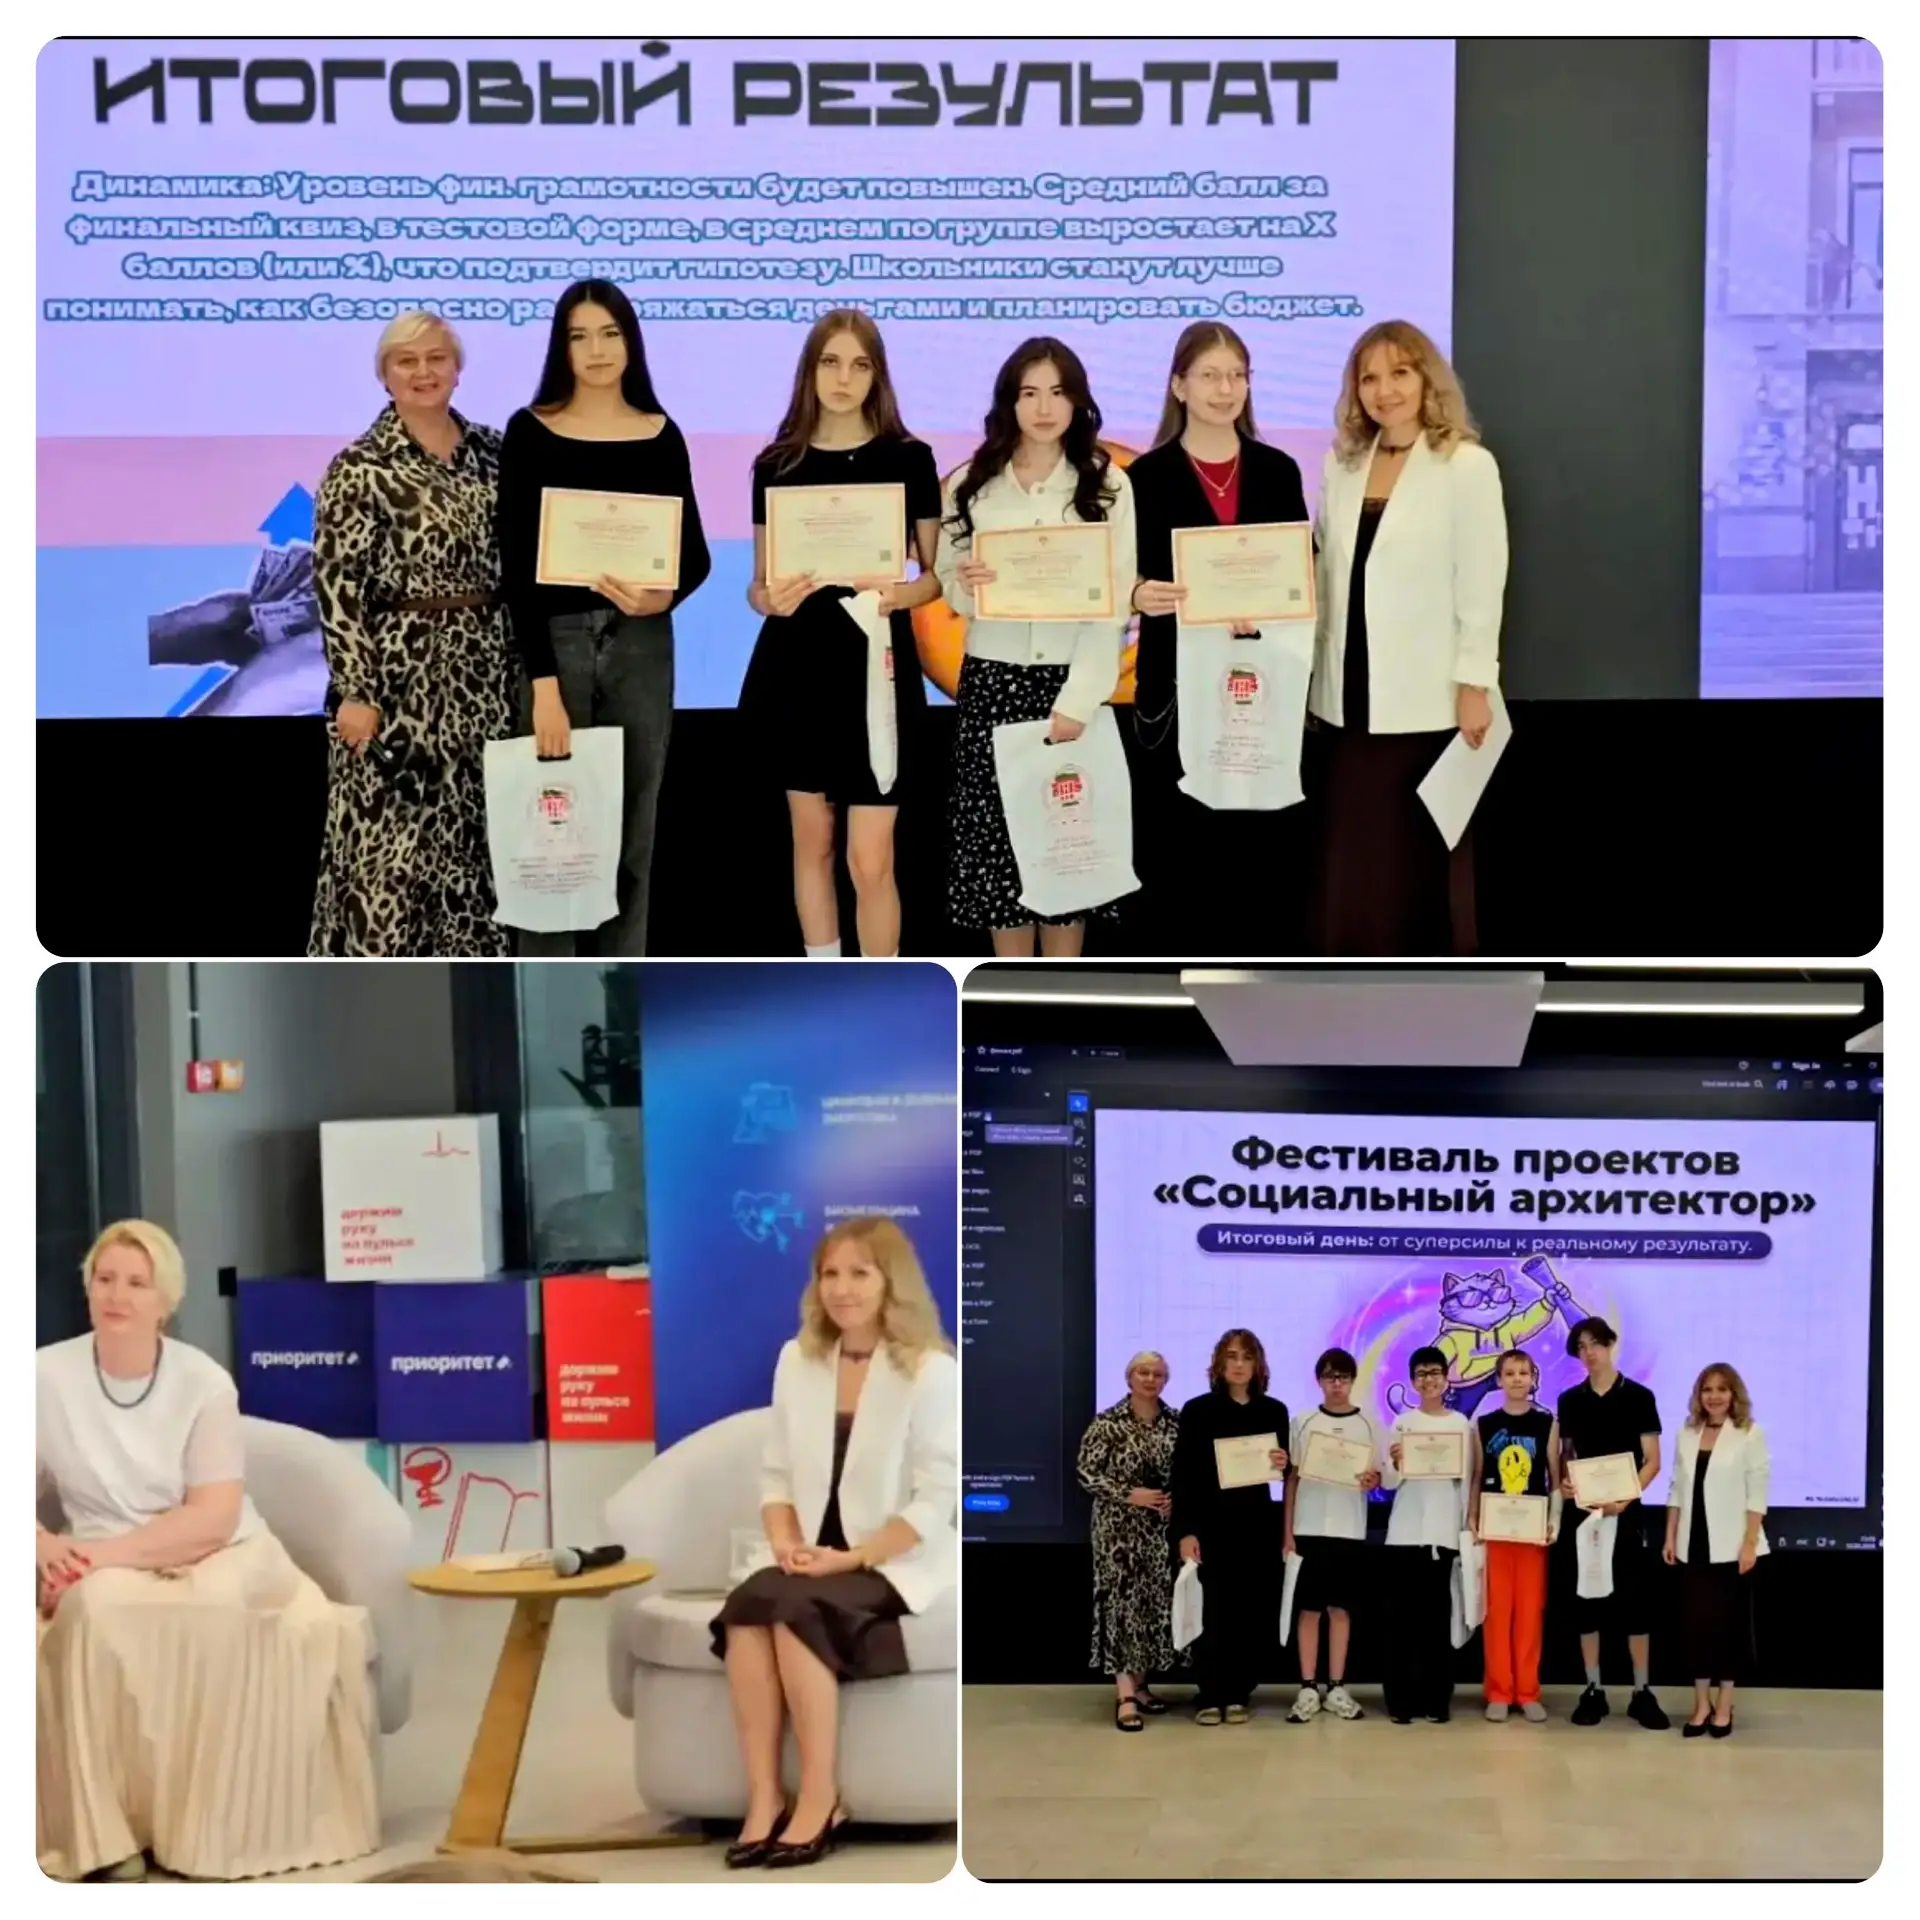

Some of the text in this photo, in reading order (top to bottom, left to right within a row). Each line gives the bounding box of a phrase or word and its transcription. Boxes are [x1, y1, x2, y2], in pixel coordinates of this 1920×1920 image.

[94, 41, 1338, 126] ИТОГОВЫЙ РЕЗУЛЬТАТ
[72, 171, 1328, 205] Динамика: Уровень фин. грамотности будет повышен. Средний балл за
[65, 212, 273, 244] финальный
[278, 217, 373, 241] квиз,
[375, 217, 399, 239] в
[402, 214, 571, 239] тестовой
[575, 215, 700, 245] форме,
[703, 218, 727, 239] в
[730, 218, 887, 244] среднем
[890, 218, 935, 239] по
[938, 218, 1060, 245] группе
[1062, 215, 1256, 244] выростает
[1258, 216, 1302, 238] на
[121, 252, 259, 279] баллов
[262, 251, 340, 280] (или
[394, 258, 462, 279] что
[464, 258, 676, 281] подтвердит
[678, 258, 848, 286] гипотезу.
[850, 254, 1046, 279] Школьники
[1050, 257, 1173, 284] станут
[1174, 256, 1284, 284] лучше
[44, 299, 235, 323] понимать,
[237, 299, 307, 320] как
[965, 299, 988, 319] и
[991, 297, 1221, 324] планировать
[1223, 291, 1364, 319] бюджет.
[1232, 1135, 1740, 1182] Фестиваль проектов
[1153, 1175, 1816, 1223] «Социальный архитектор»
[1217, 1231, 1752, 1255] Итоговый день: от суперсилы к реальному результату.
[251, 1350, 345, 1368] приоритет
[390, 1354, 494, 1374] приоритет
